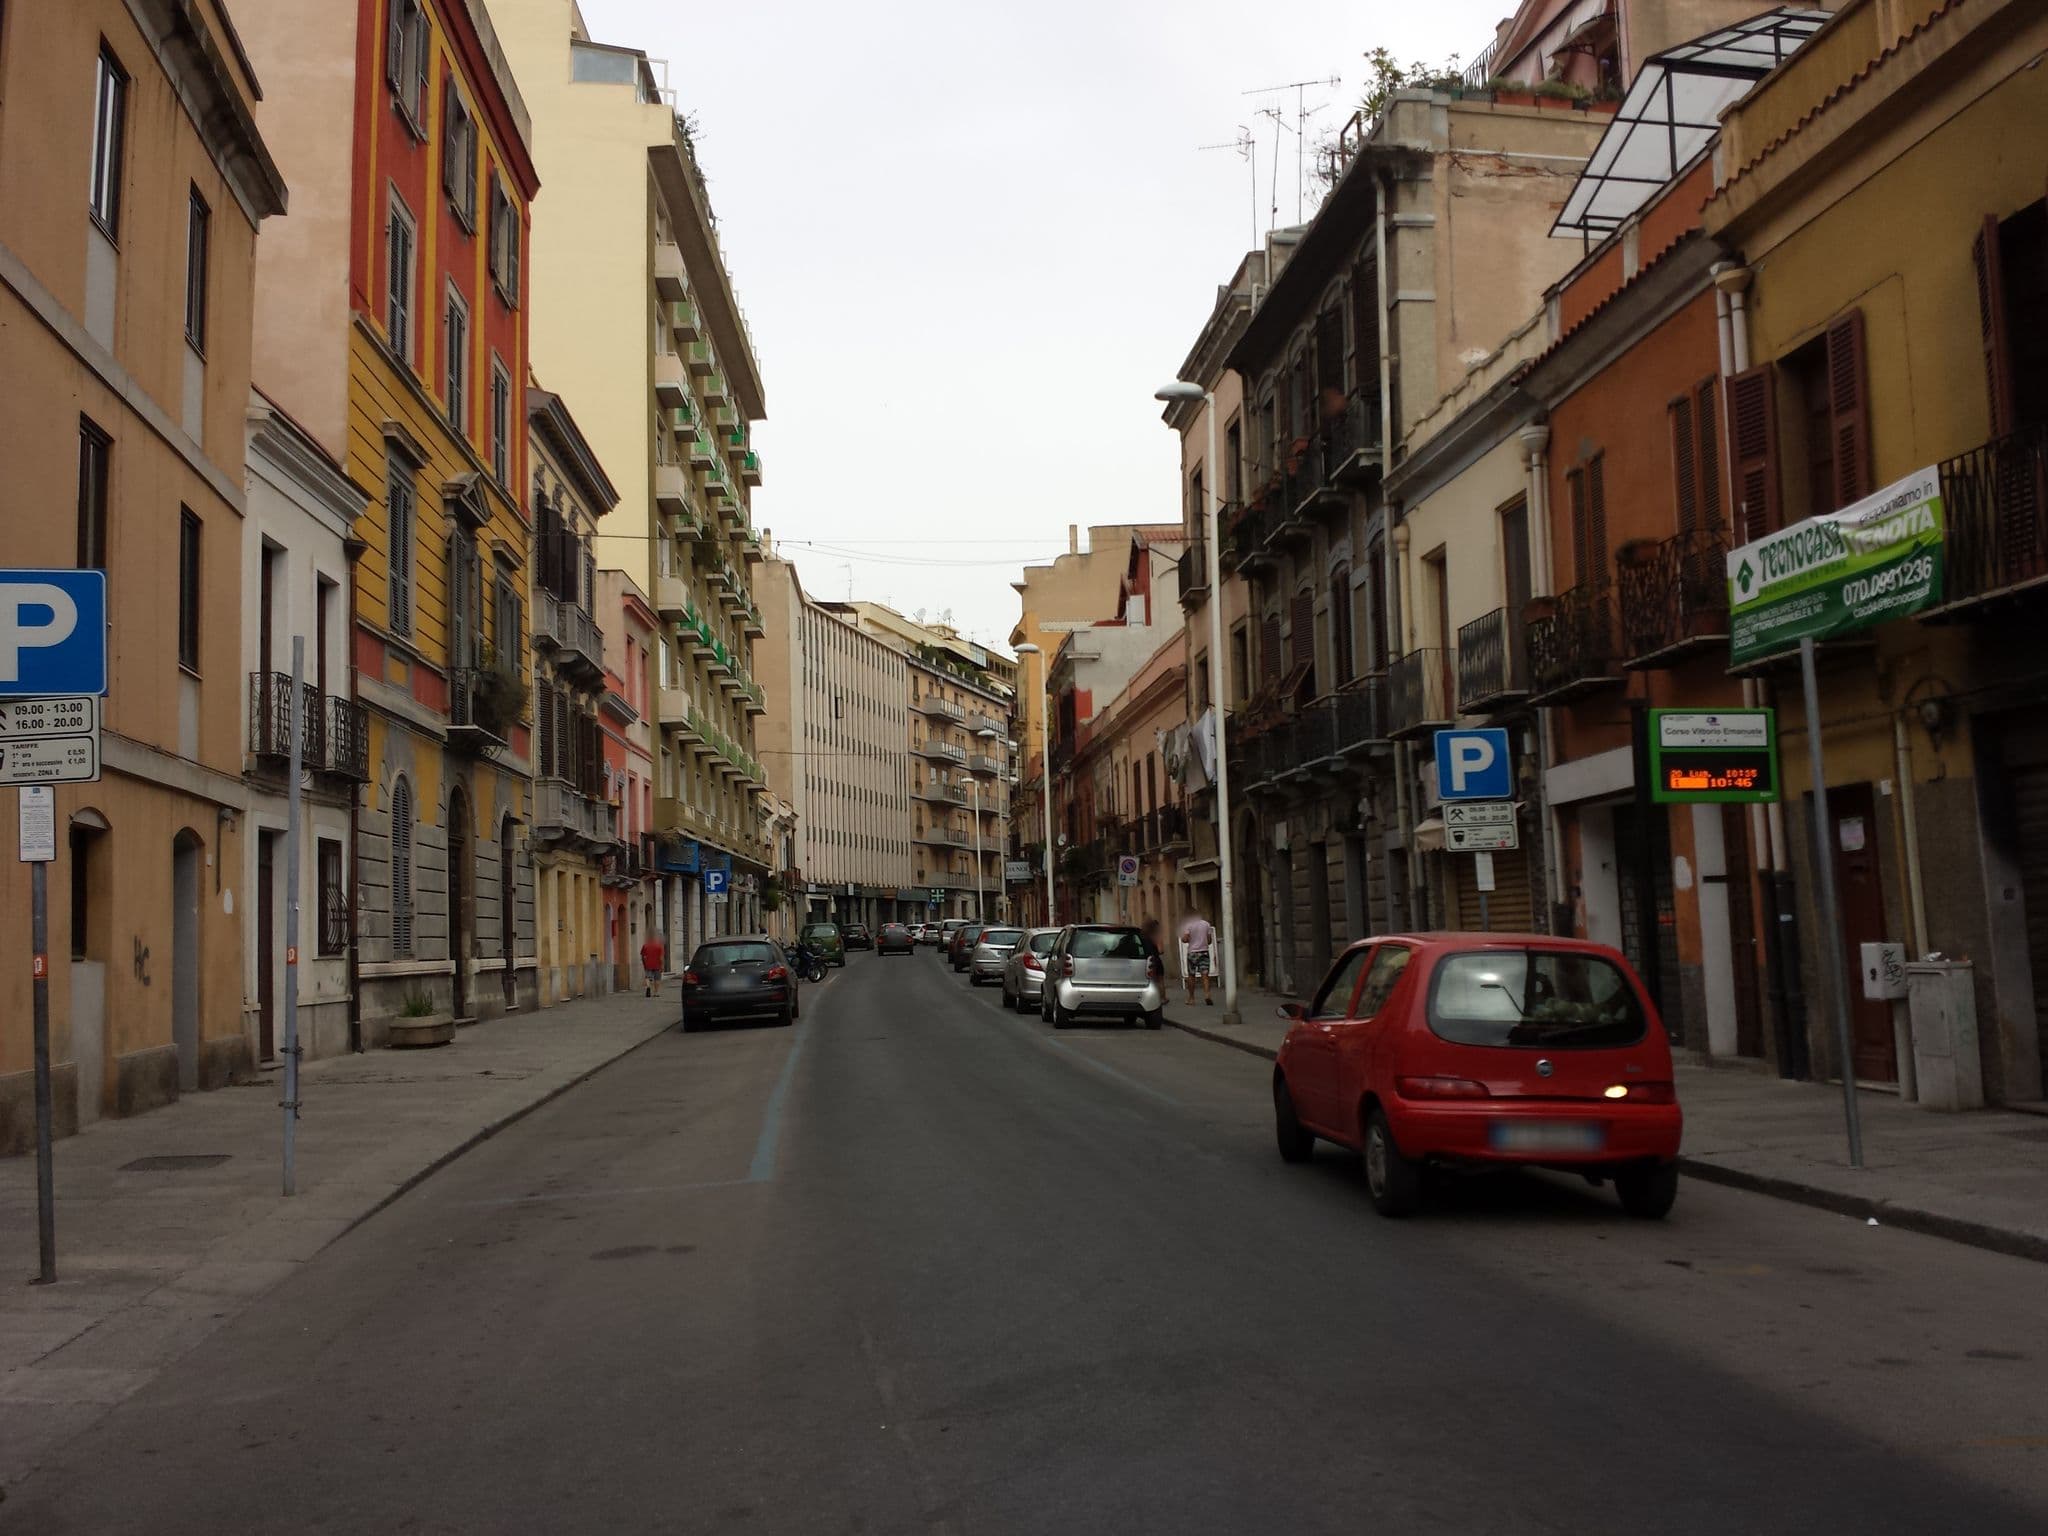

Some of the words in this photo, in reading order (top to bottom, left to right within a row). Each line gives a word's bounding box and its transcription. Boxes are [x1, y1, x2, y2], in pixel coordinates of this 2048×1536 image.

[1848, 503, 1937, 556] VENDITA
[0, 582, 78, 682] P
[15, 705, 44, 716] 09.00
[53, 702, 83, 714] 13.00
[15, 719, 44, 730] 16.00
[53, 717, 83, 728] 20.00
[1665, 727, 1689, 736] Corso
[1724, 727, 1763, 736] Emanuele
[1449, 737, 1495, 792] P
[710, 873, 723, 890] P
